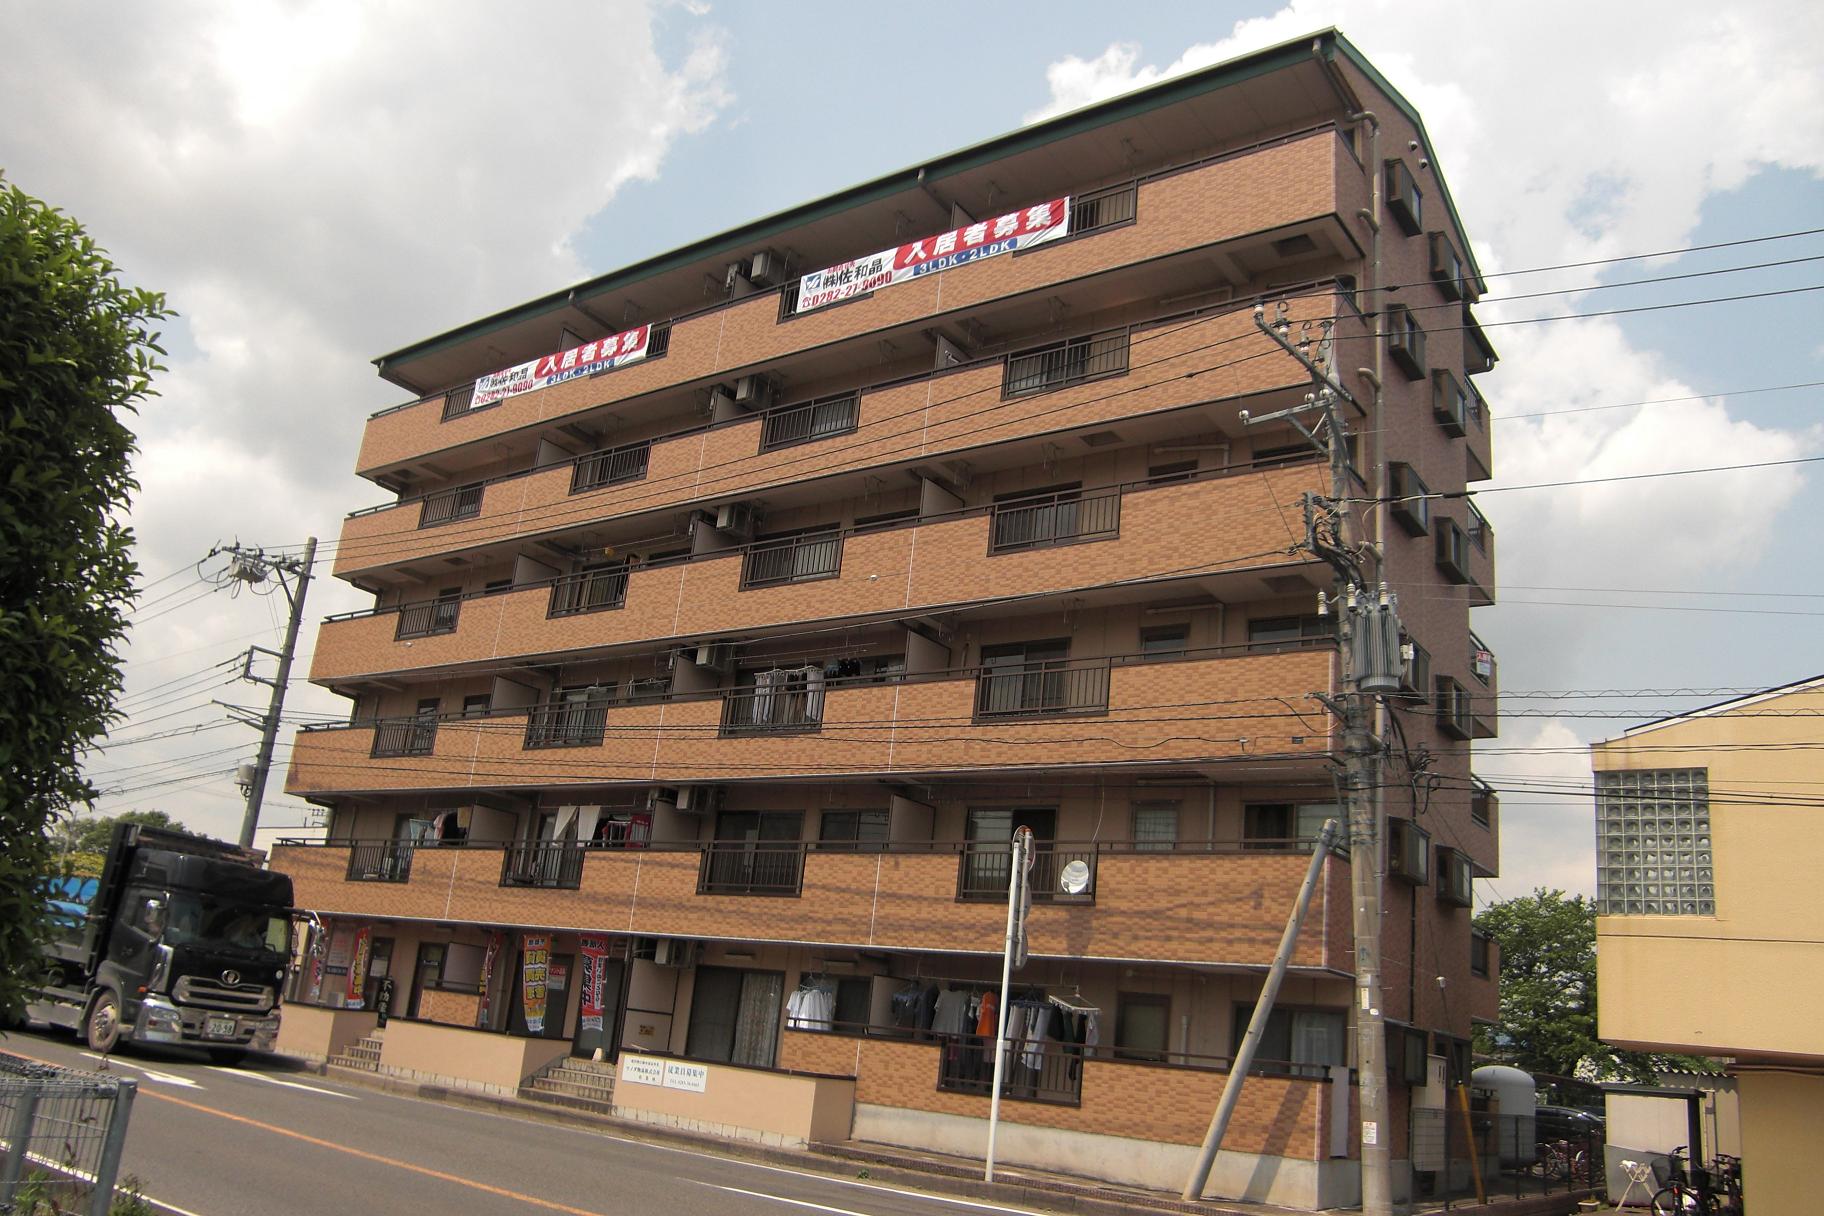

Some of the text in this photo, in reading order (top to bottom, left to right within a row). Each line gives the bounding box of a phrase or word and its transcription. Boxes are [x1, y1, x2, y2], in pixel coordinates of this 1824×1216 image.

[904, 203, 1052, 264] 入居者募集
[541, 331, 639, 374] 入居者募集
